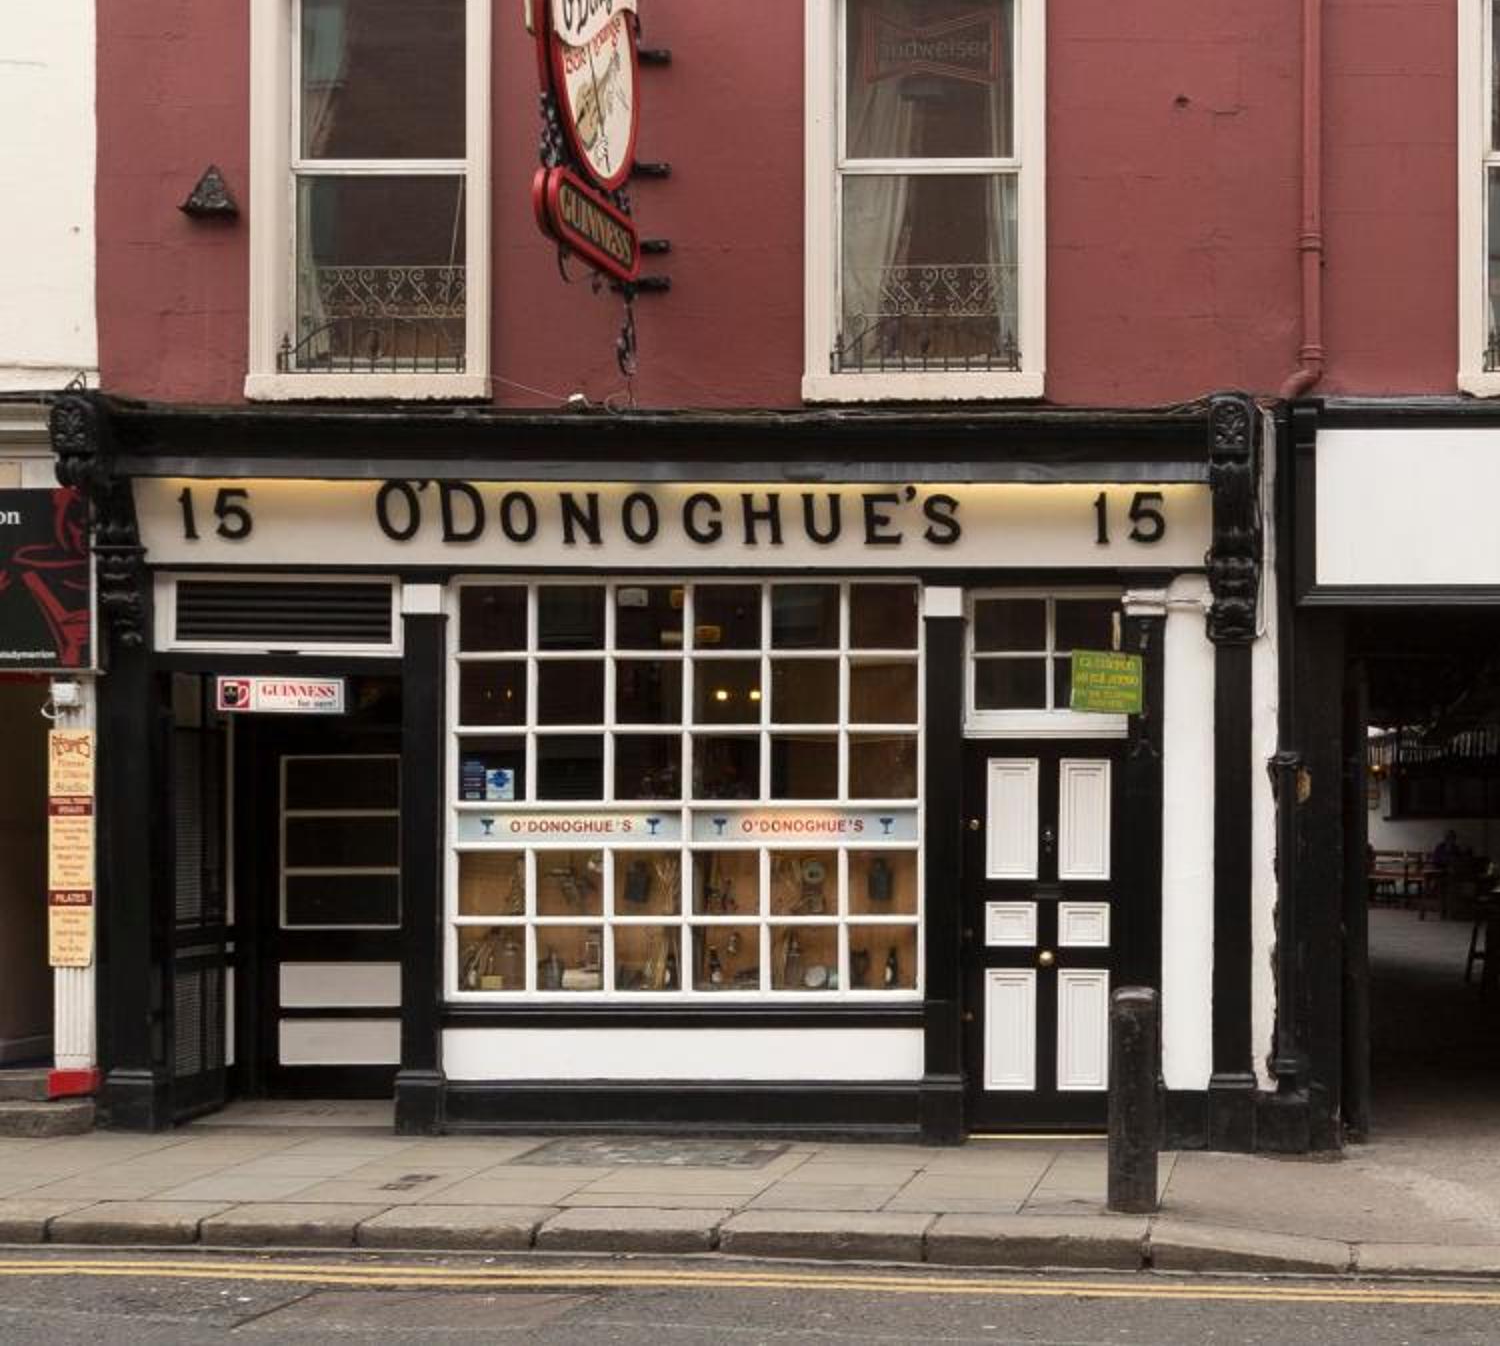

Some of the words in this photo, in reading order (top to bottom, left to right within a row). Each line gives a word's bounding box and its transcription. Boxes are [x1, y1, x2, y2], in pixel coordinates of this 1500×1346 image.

[560, 184, 631, 265] GUINNESS
[178, 488, 254, 540] 15
[376, 480, 963, 546] O'DONOGHUE'S
[1093, 491, 1167, 544] 15
[262, 684, 336, 698] GUINNESS
[742, 818, 864, 834] O'DONOGHUE'S
